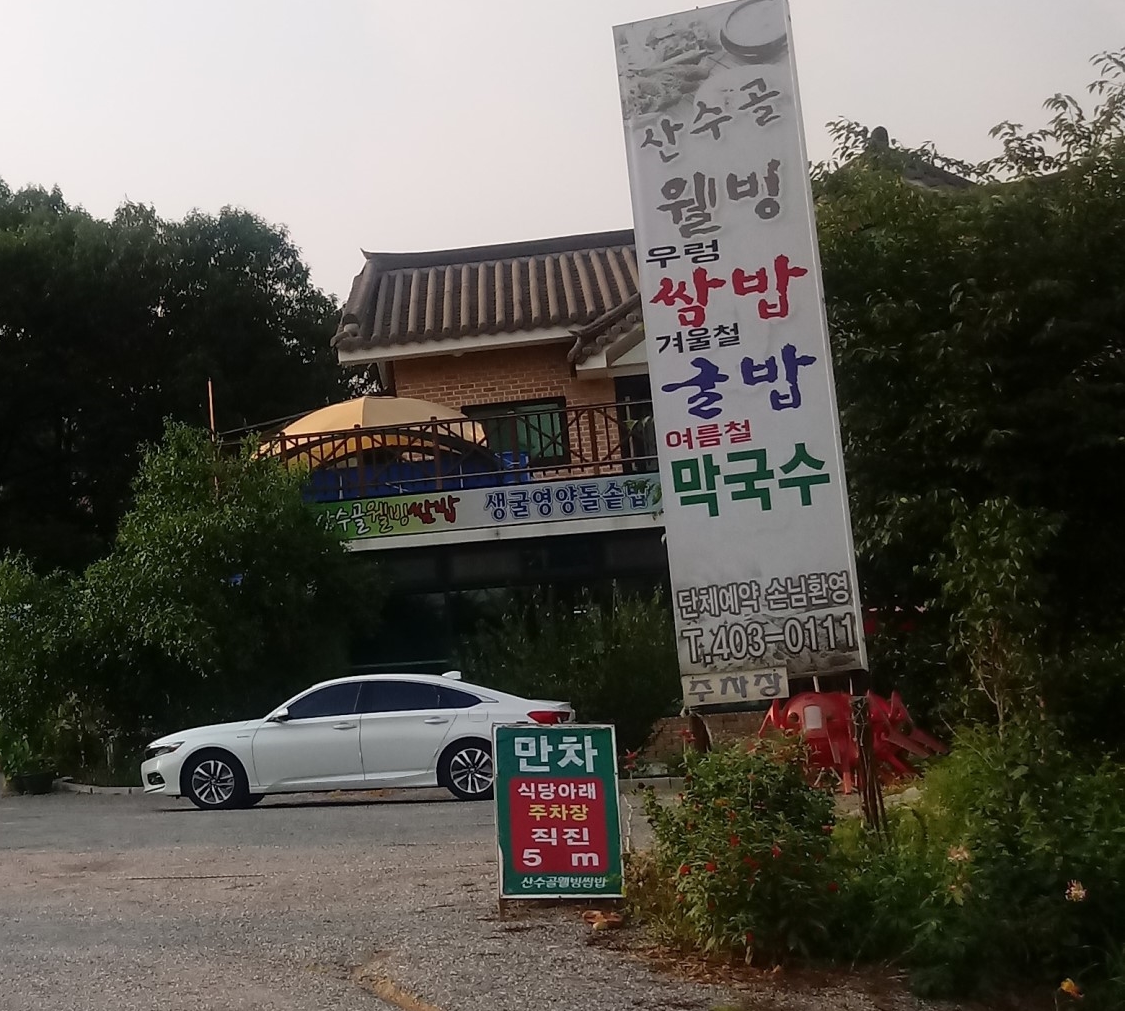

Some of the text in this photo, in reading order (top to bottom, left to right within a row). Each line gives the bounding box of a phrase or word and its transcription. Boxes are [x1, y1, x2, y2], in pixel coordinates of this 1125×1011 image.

[640, 77, 781, 163] 산수골
[656, 158, 781, 239] 웰빙
[645, 239, 721, 269] 우렁
[649, 254, 808, 328] 쌈밥
[655, 322, 741, 354] 겨울철
[661, 343, 817, 419] 굴밥
[665, 419, 752, 450] 여름철
[671, 442, 831, 517] 막국수
[677, 570, 851, 620] 단체예약 손님환영
[688, 672, 783, 702] 주차장
[514, 735, 599, 773] 만차
[517, 782, 597, 800] 식당아래
[528, 803, 589, 821] 주차장
[531, 827, 590, 846] 직진
